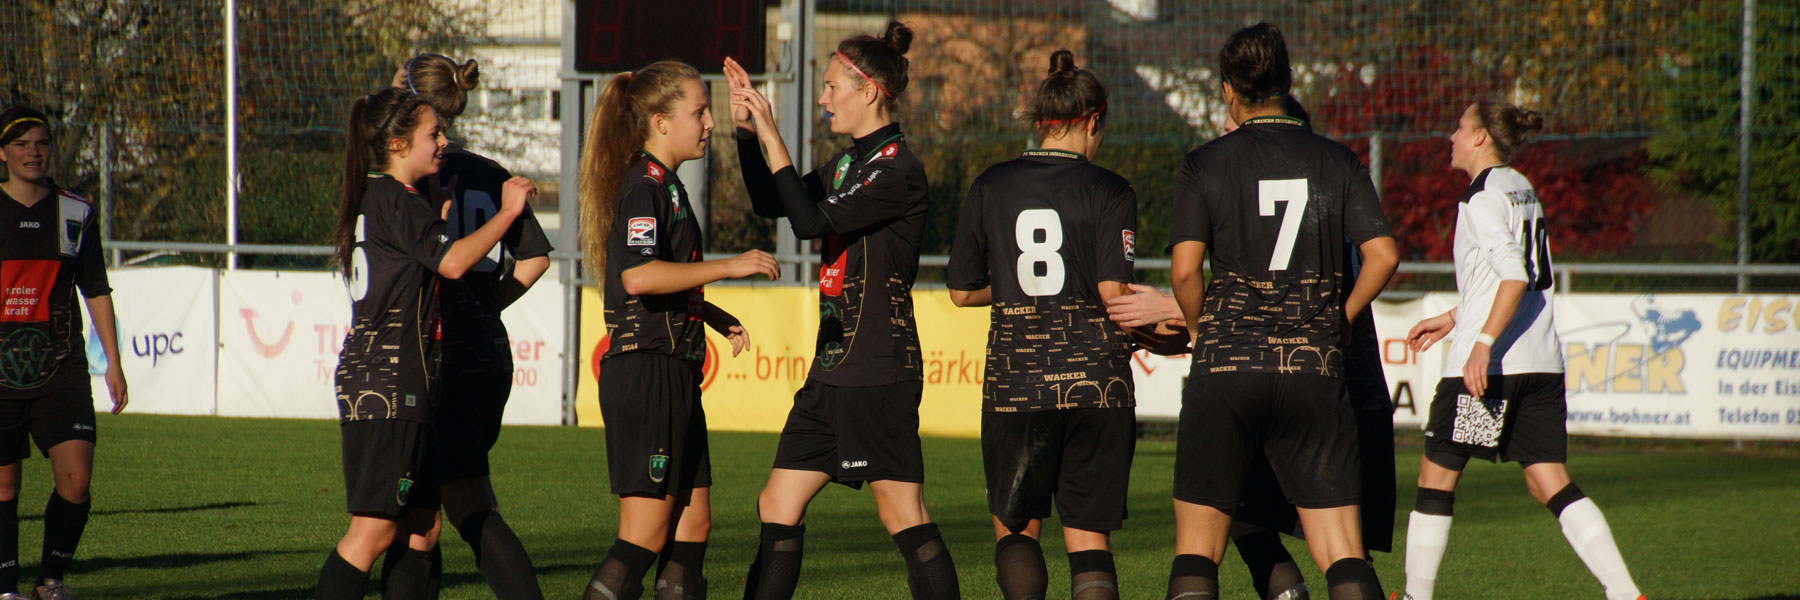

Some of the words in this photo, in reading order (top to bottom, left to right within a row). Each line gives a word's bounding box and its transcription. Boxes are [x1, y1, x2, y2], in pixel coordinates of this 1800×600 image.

[19, 221, 40, 229] JAKO
[1258, 178, 1308, 271] 7
[1016, 209, 1065, 296] 8
[1523, 217, 1553, 291] 10
[1236, 278, 1273, 289] CKER
[4, 306, 29, 316] kraft
[1717, 296, 1800, 334] EIS
[132, 331, 184, 368] upc
[1267, 336, 1309, 345] WACKER
[755, 345, 806, 382] brin
[922, 350, 984, 386] ärku
[1210, 365, 1237, 373] WACKER
[1716, 349, 1800, 370] EQUIPME
[313, 360, 336, 387] Ty
[512, 367, 537, 388] 00
[1043, 371, 1087, 381] WACKER
[1049, 378, 1130, 411] 100
[1718, 380, 1734, 395] In
[1740, 380, 1768, 395] der
[1775, 380, 1800, 395] Eis
[1718, 407, 1780, 423] Telefon
[1786, 408, 1800, 424] 0
[850, 460, 868, 468] JAKO
[0, 559, 15, 569] KO
